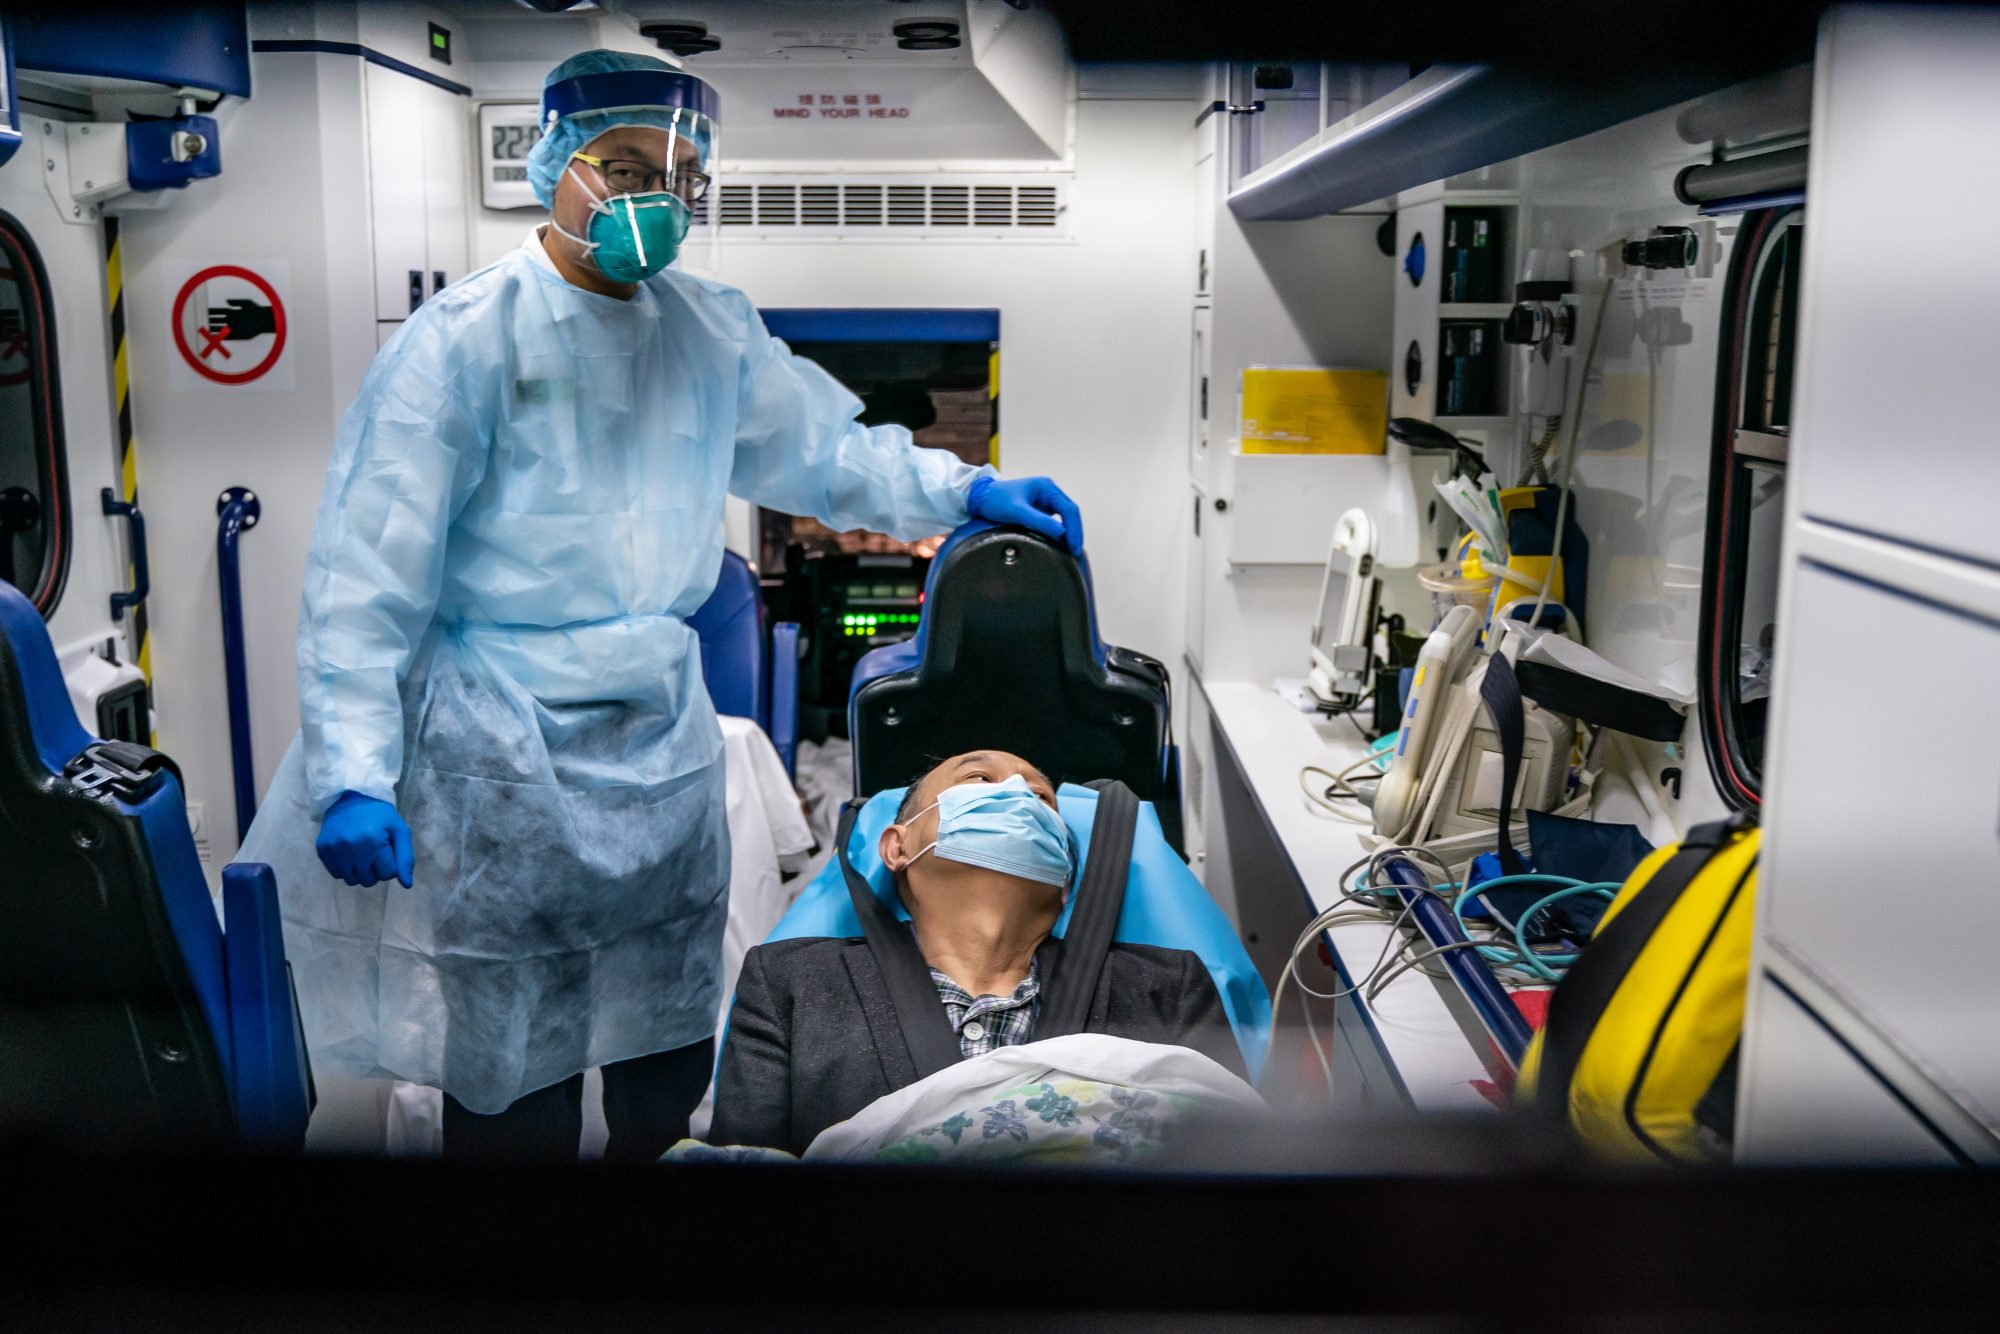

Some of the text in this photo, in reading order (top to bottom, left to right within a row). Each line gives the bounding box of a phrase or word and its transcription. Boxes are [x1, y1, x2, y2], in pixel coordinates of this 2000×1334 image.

[773, 108, 909, 118] MIND YOUR HEAD
